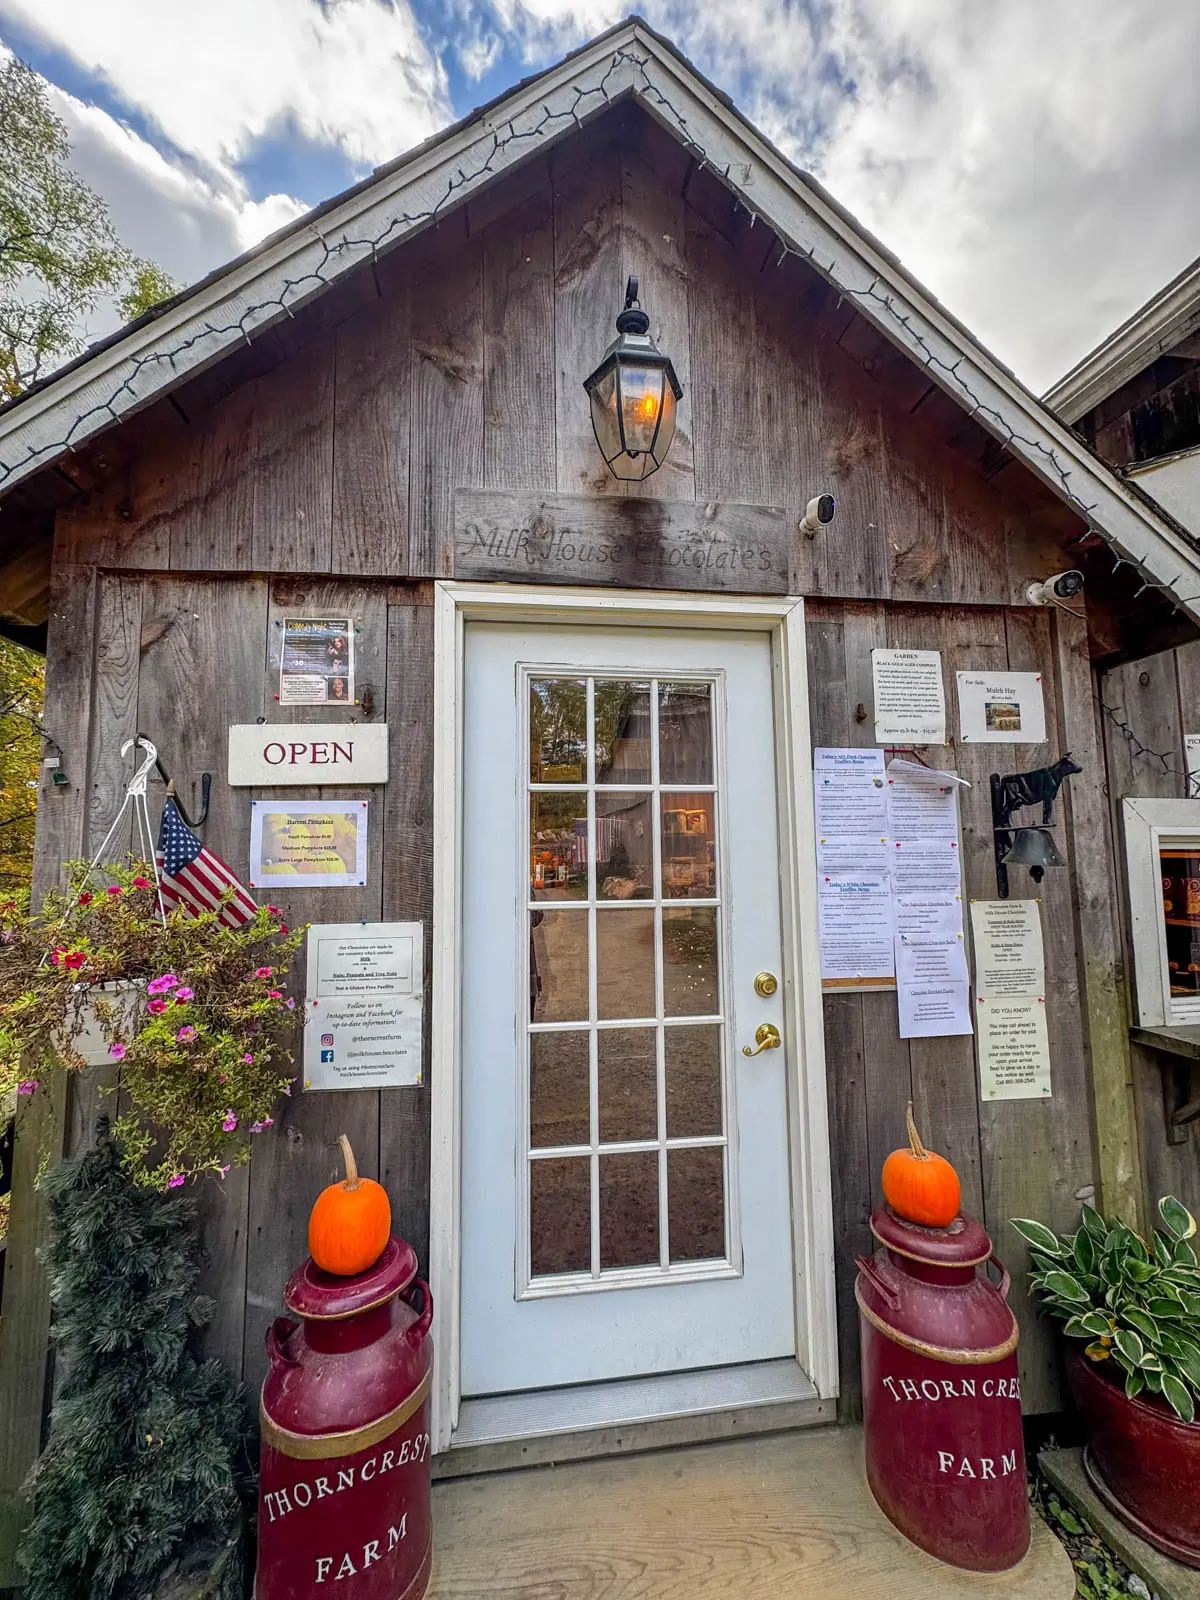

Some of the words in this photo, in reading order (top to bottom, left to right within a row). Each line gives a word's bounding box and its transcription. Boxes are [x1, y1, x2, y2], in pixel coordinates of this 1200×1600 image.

[462, 523, 535, 564] Milk
[540, 527, 622, 562] House
[1004, 687, 1016, 695] Hay
[263, 741, 354, 765] OPEN
[326, 1012, 354, 1020] Instagram
[391, 1010, 403, 1018] for
[361, 1019, 397, 1028] information!
[352, 1034, 402, 1043] @thorncrestfarm
[882, 1375, 1022, 1402] THORNCRES
[937, 1449, 1017, 1480] FARM
[264, 1432, 429, 1523] THORNCREST
[315, 1512, 408, 1583] FARM
